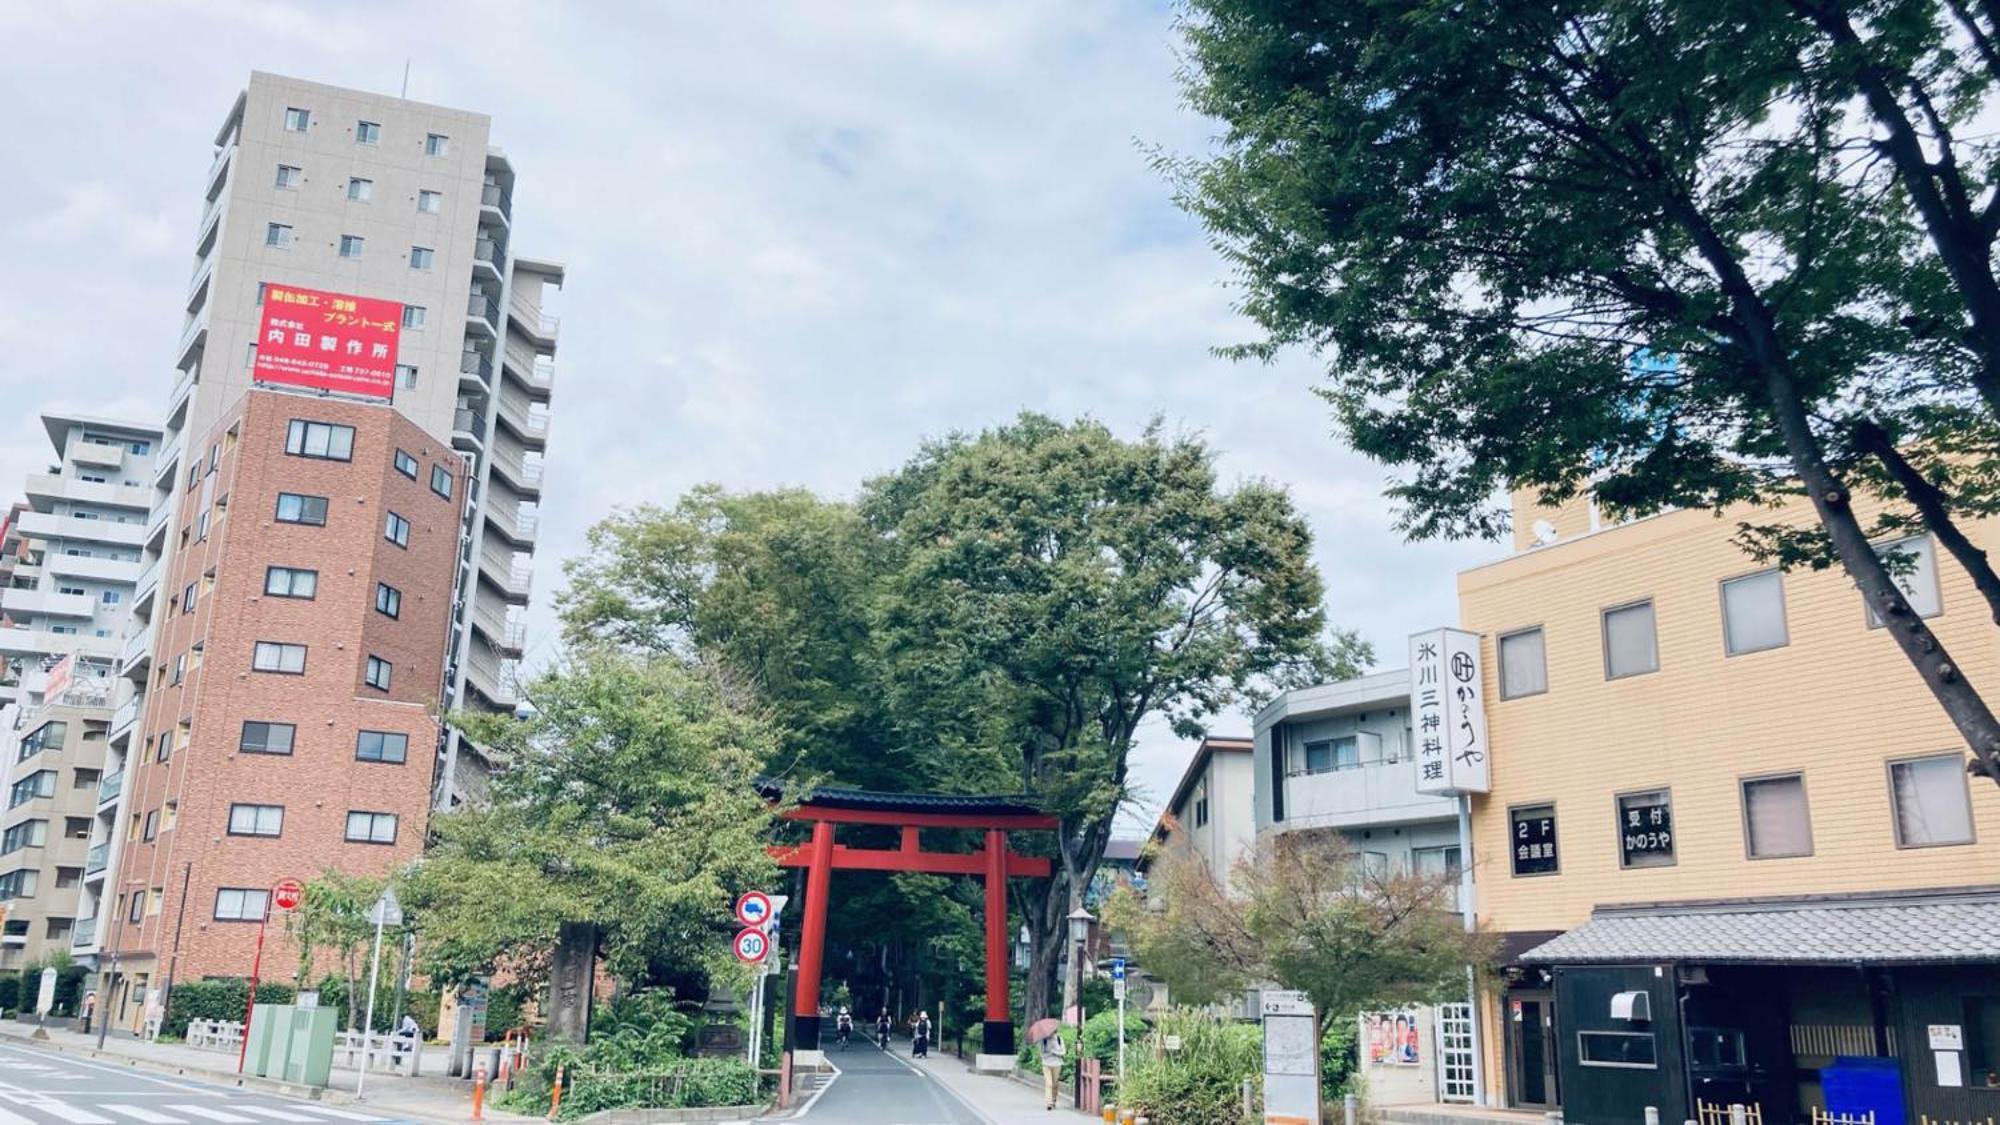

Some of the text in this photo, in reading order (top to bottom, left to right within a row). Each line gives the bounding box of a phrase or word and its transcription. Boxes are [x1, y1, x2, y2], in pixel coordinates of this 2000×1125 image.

[269, 318, 305, 331] 株式会社
[267, 329, 389, 360] 内田製作所
[1418, 642, 1444, 780] 氷川三神料理
[1628, 807, 1663, 827] 受付
[1625, 831, 1670, 850] かのうや
[1518, 843, 1554, 860] 会議室
[742, 938, 761, 954] 30
